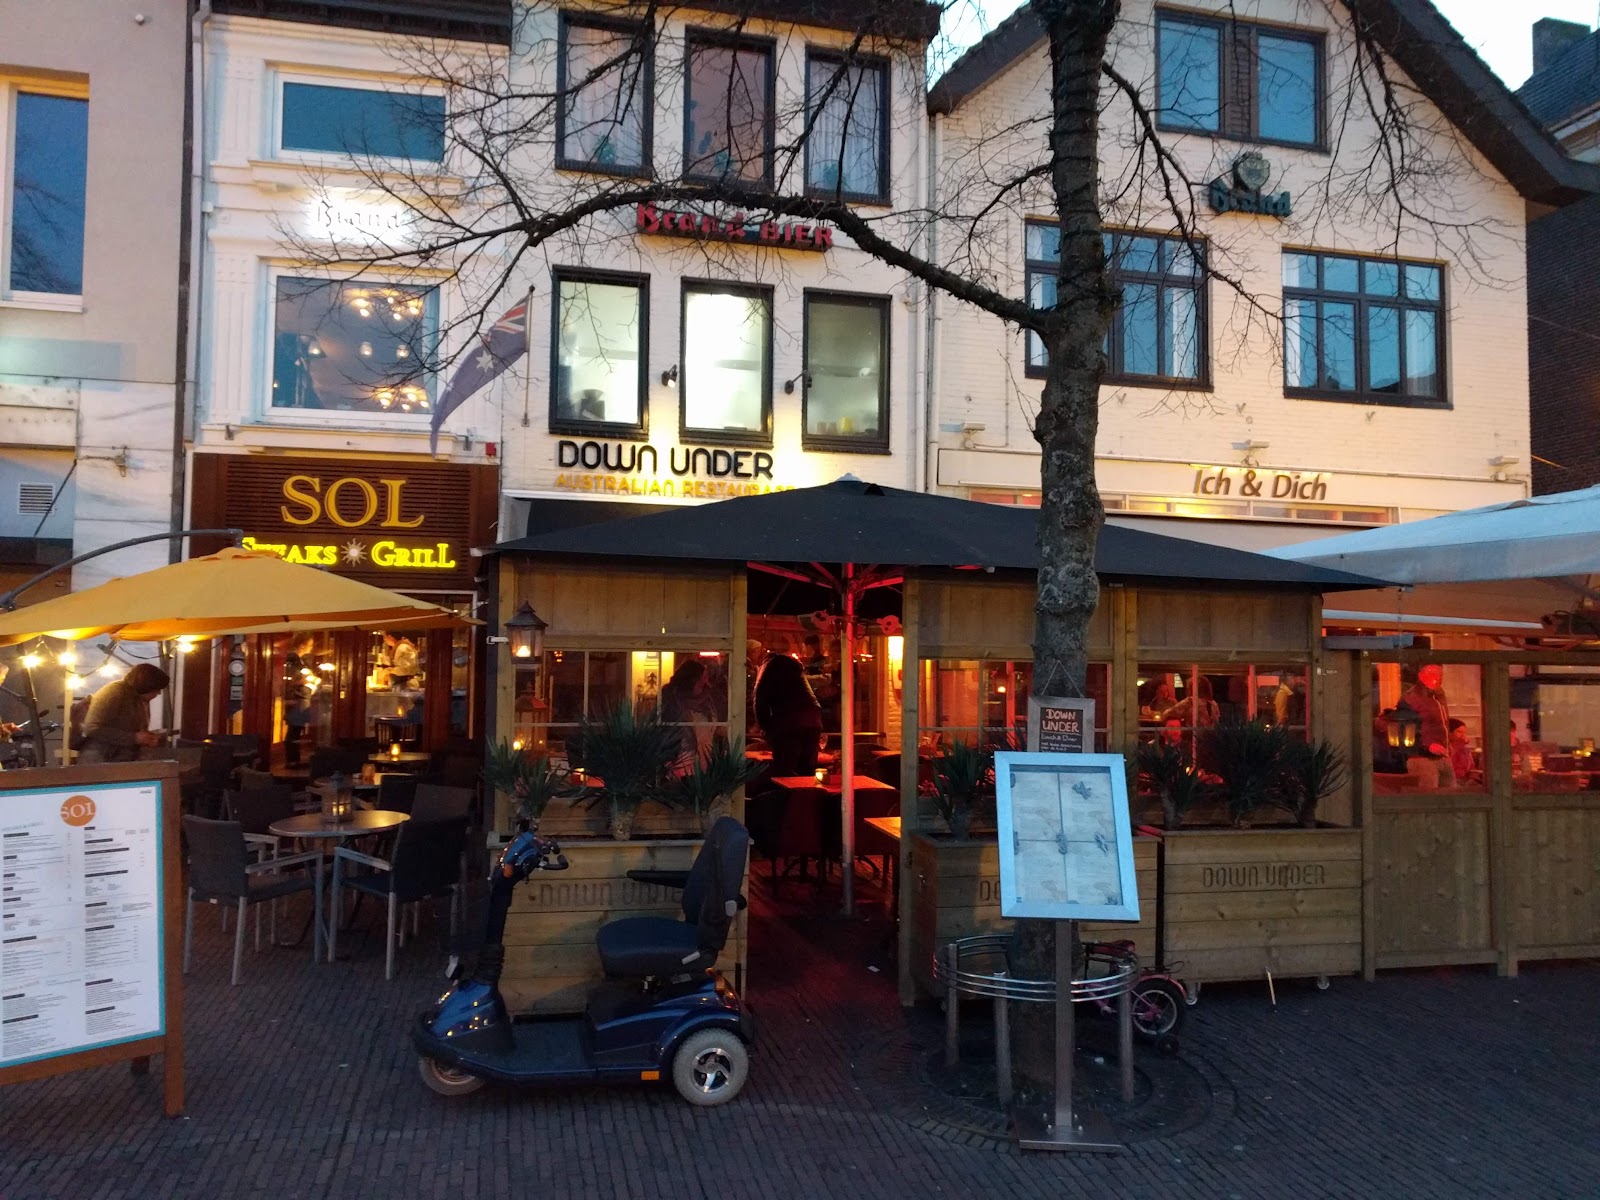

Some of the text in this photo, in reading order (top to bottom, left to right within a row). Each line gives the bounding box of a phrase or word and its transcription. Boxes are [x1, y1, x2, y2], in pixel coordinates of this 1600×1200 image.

[759, 219, 833, 247] BIER
[558, 440, 774, 479] DOWN UNDER
[555, 473, 675, 497] AUSTRALIAN
[1192, 469, 1327, 501] Ich & Dich
[281, 475, 425, 528] SOL
[1045, 708, 1076, 720] DOWN
[1042, 720, 1080, 733] UNDER
[60, 801, 96, 820] SOL
[1203, 867, 1259, 888] DOWN
